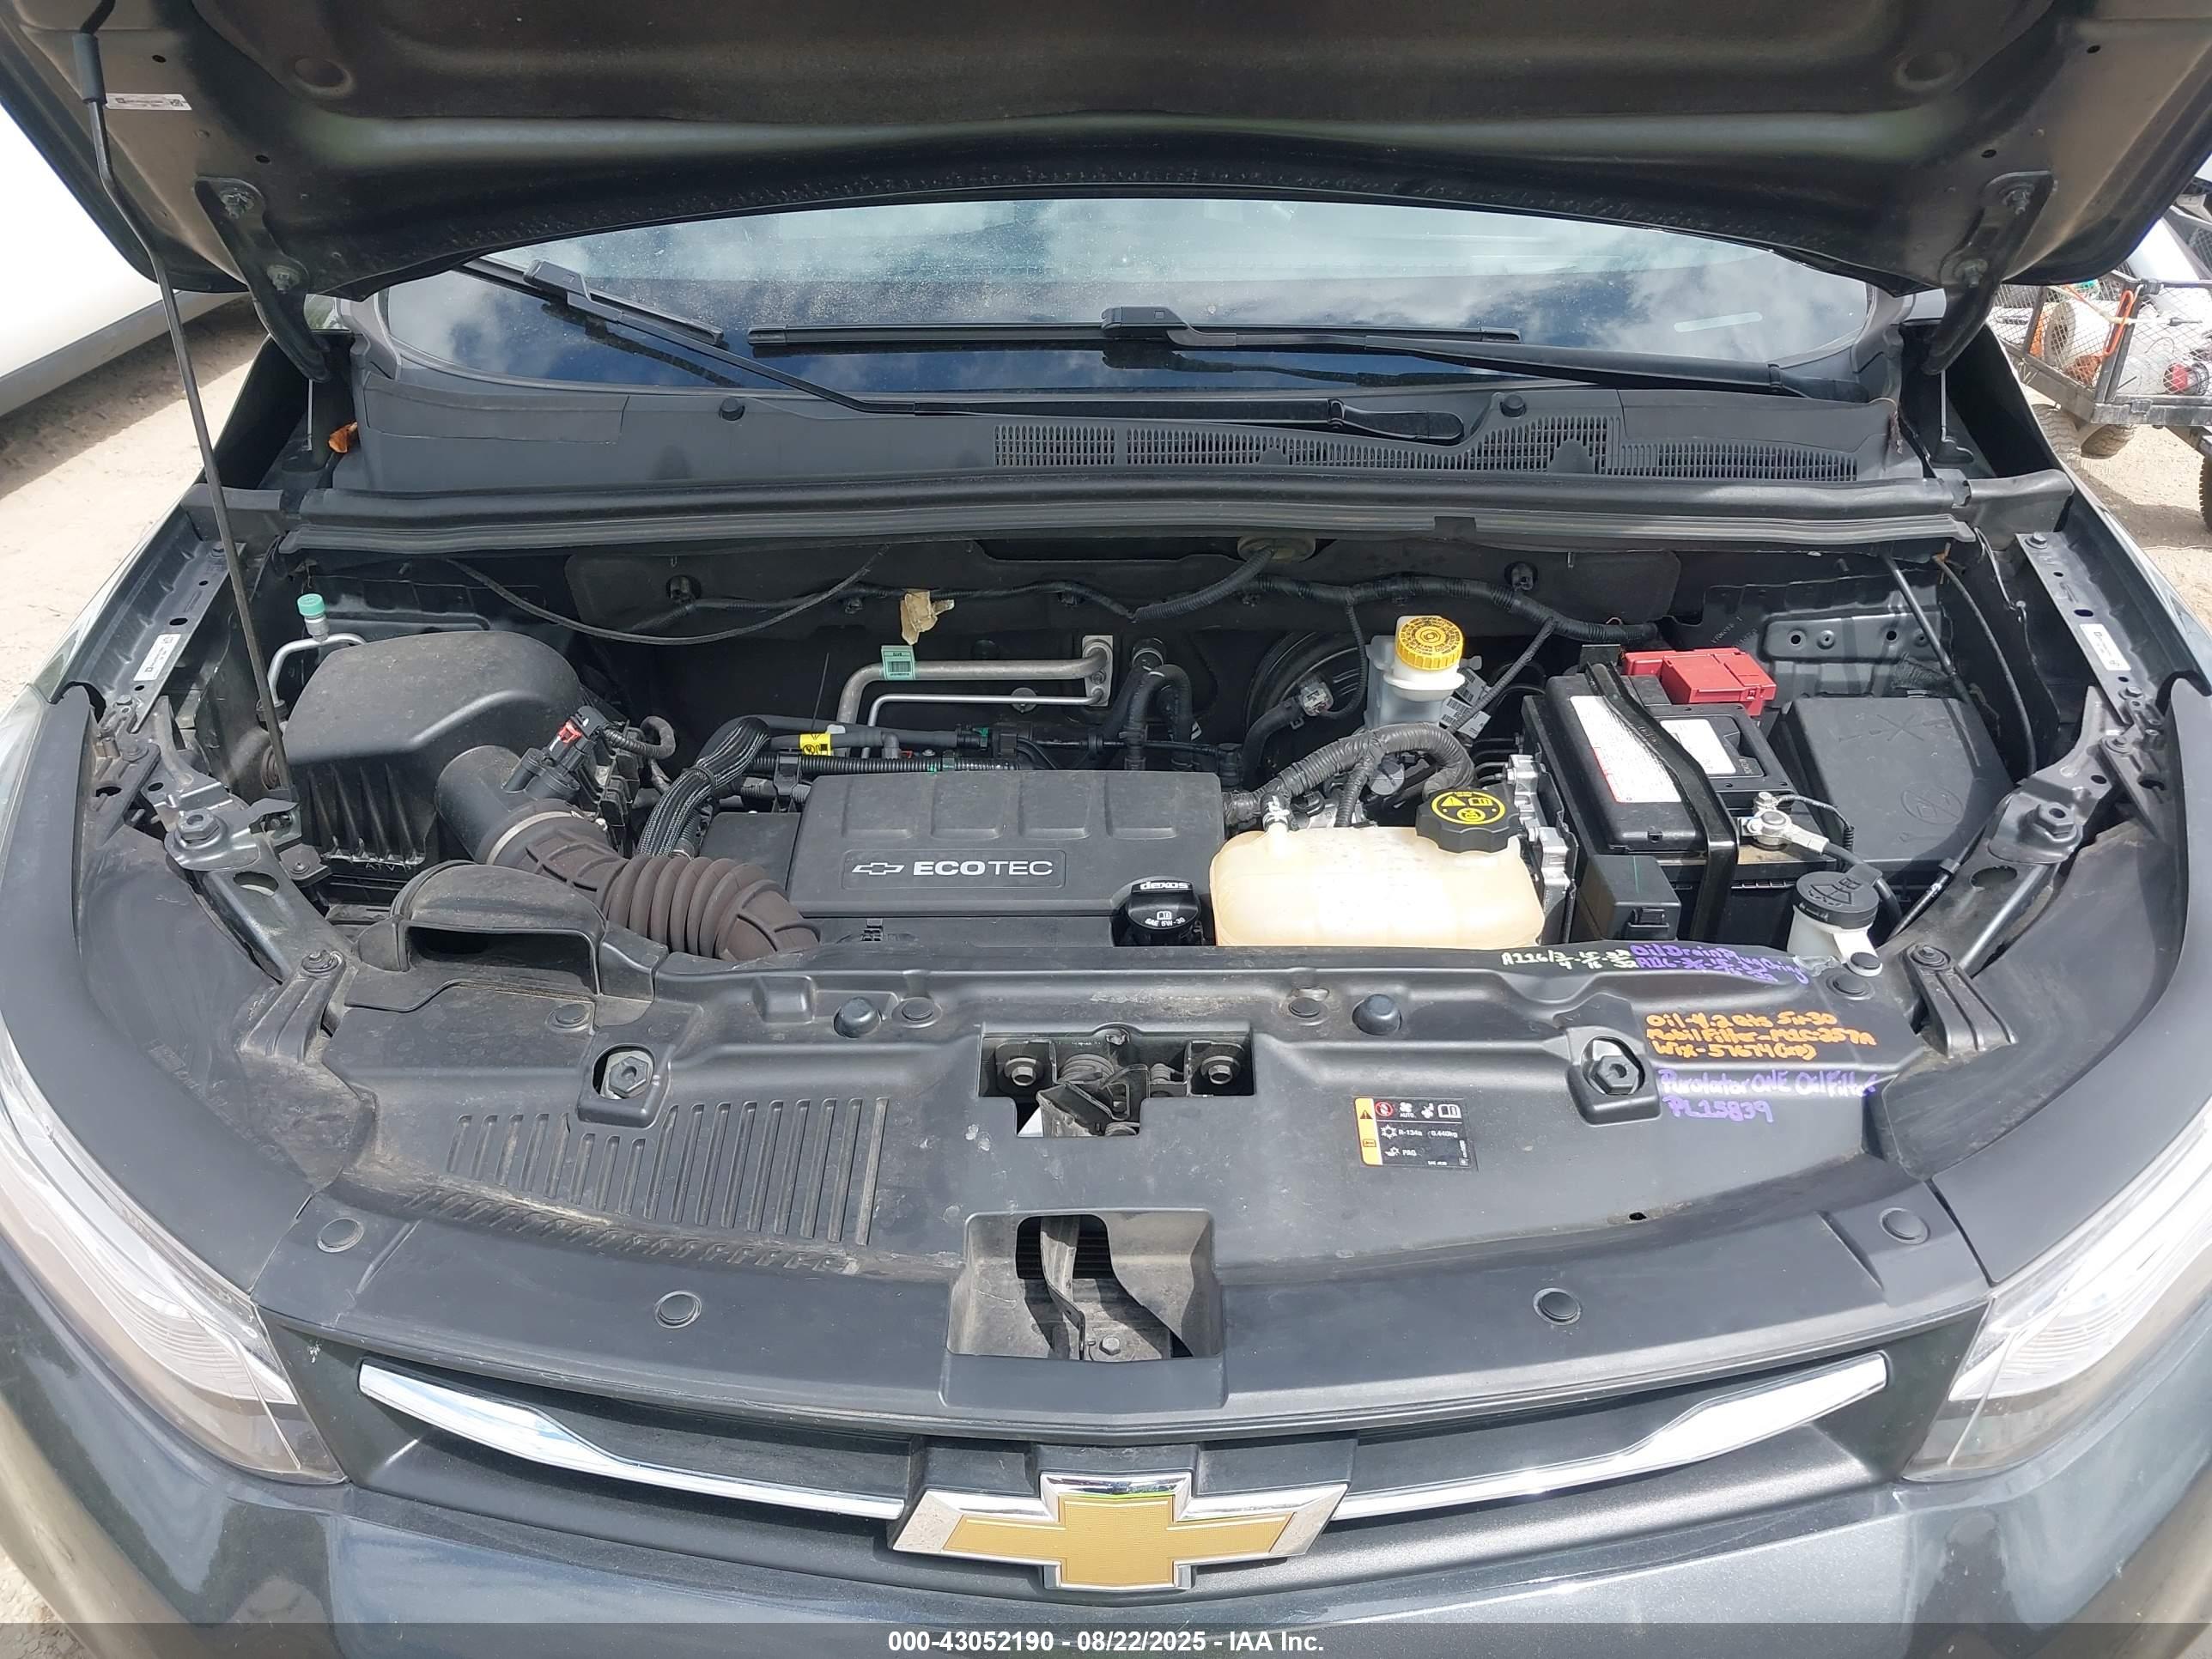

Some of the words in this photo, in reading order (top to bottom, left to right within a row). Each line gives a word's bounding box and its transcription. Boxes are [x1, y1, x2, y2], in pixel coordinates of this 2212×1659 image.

[913, 860, 1054, 876] ECOTEC
[1139, 881, 1189, 890] dexos
[1161, 915, 1186, 927] 5W-30
[1658, 1068, 1750, 1095] Purolator
